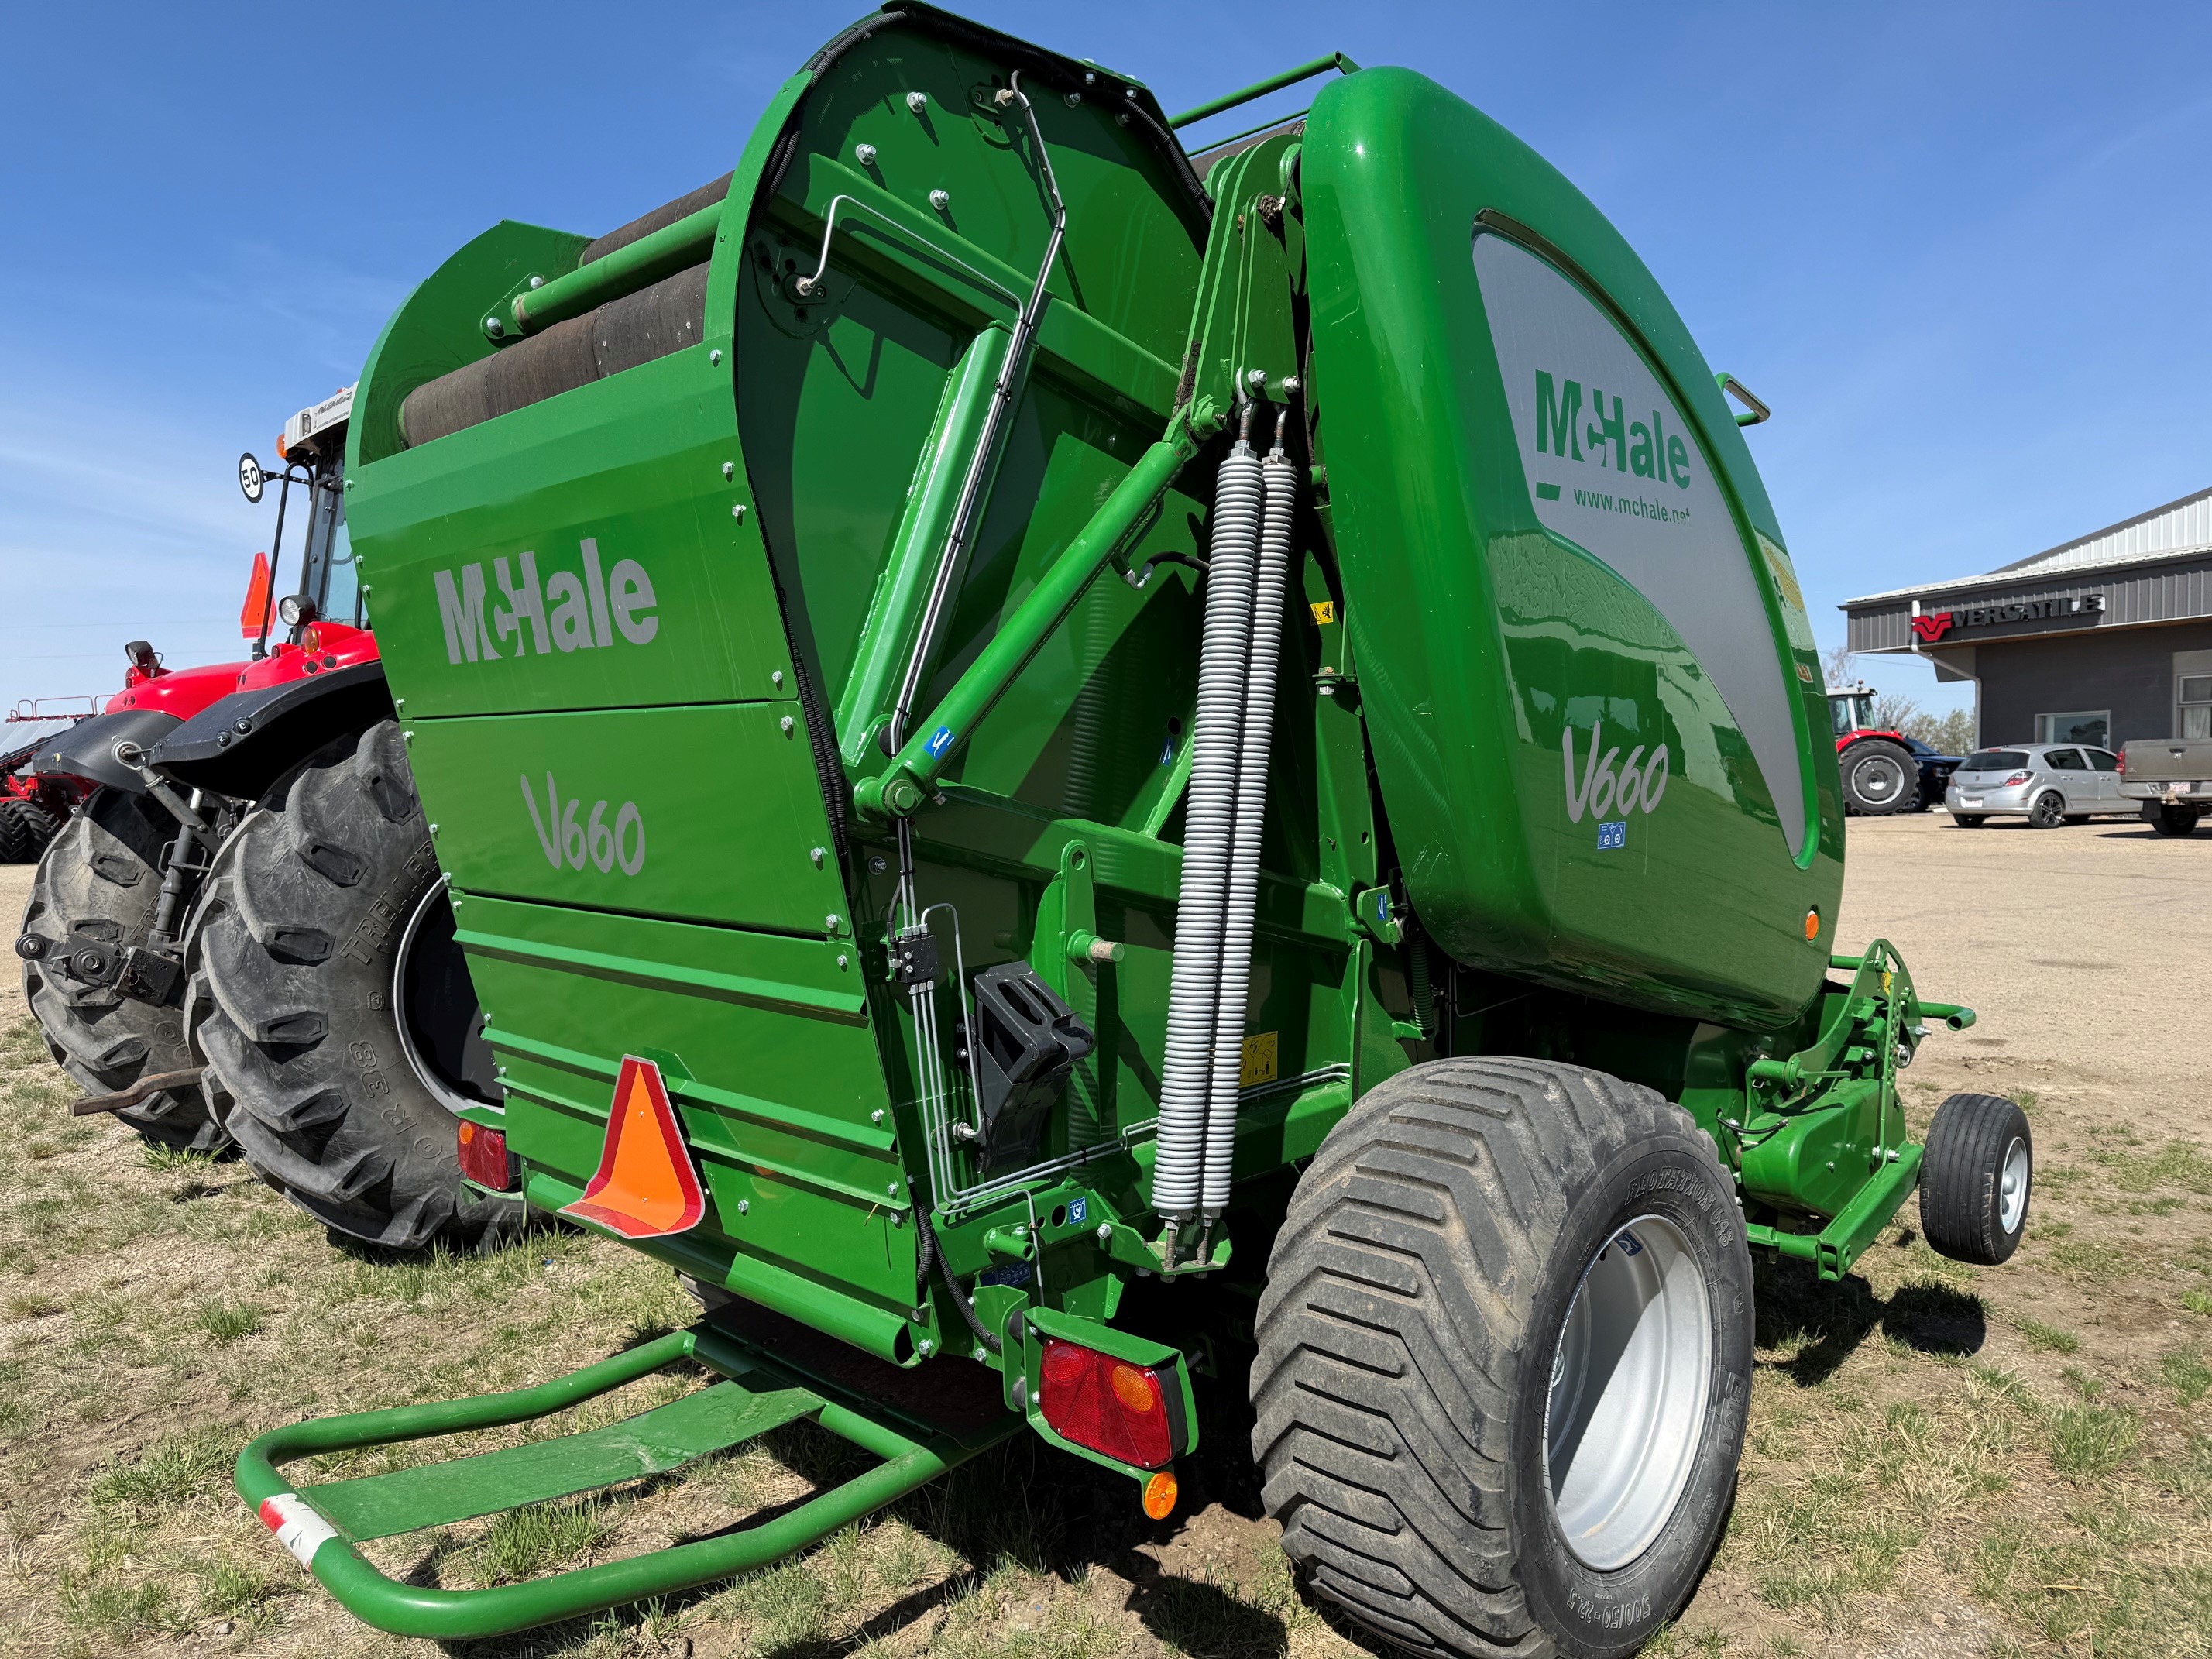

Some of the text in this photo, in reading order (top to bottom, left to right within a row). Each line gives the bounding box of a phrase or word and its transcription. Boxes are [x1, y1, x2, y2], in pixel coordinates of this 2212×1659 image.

[1535, 369, 1691, 489] McHale
[242, 466, 259, 489] 50
[433, 537, 659, 665] McHale
[1952, 594, 2104, 627] VERSATILE
[1561, 720, 1669, 824] V660
[520, 770, 646, 877] V660
[349, 1039, 390, 1098] 38
[380, 1102, 417, 1135] R
[1623, 1166, 1734, 1248] FLOTATION 648
